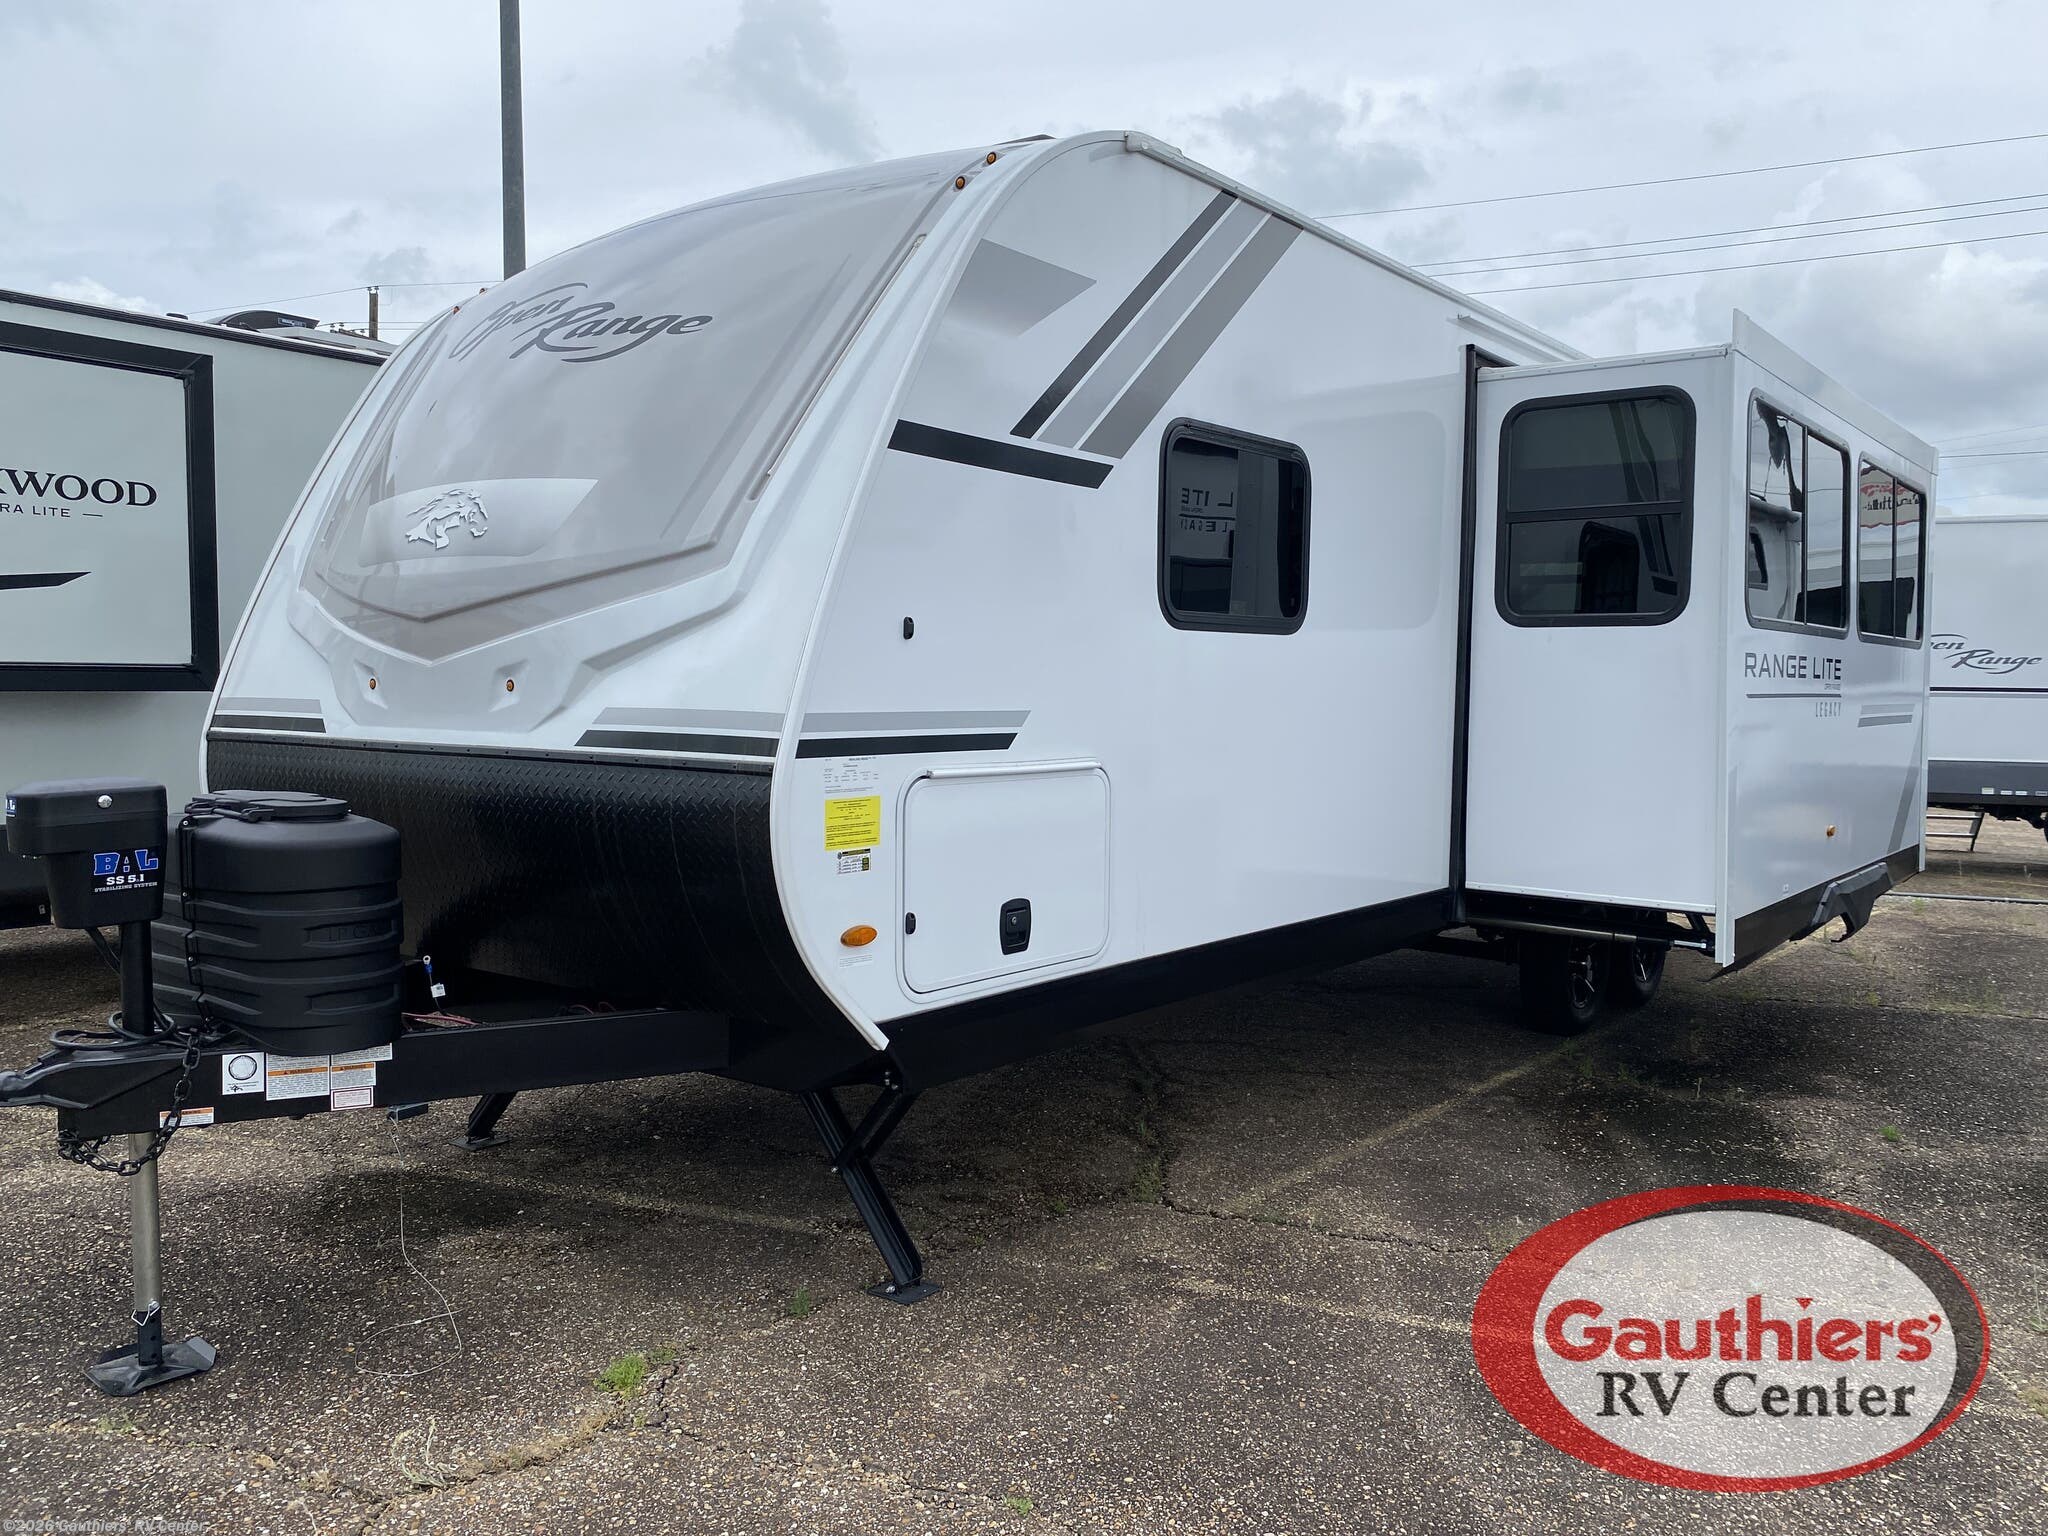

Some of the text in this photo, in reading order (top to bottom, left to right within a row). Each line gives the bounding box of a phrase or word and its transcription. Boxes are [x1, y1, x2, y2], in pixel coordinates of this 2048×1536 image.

[509, 301, 713, 363] Range
[32, 505, 71, 518] LITE
[1744, 652, 1842, 681] RANGE LITE
[1944, 649, 2042, 675] Range
[94, 849, 158, 876] BAL
[106, 873, 144, 886] SS 5.1
